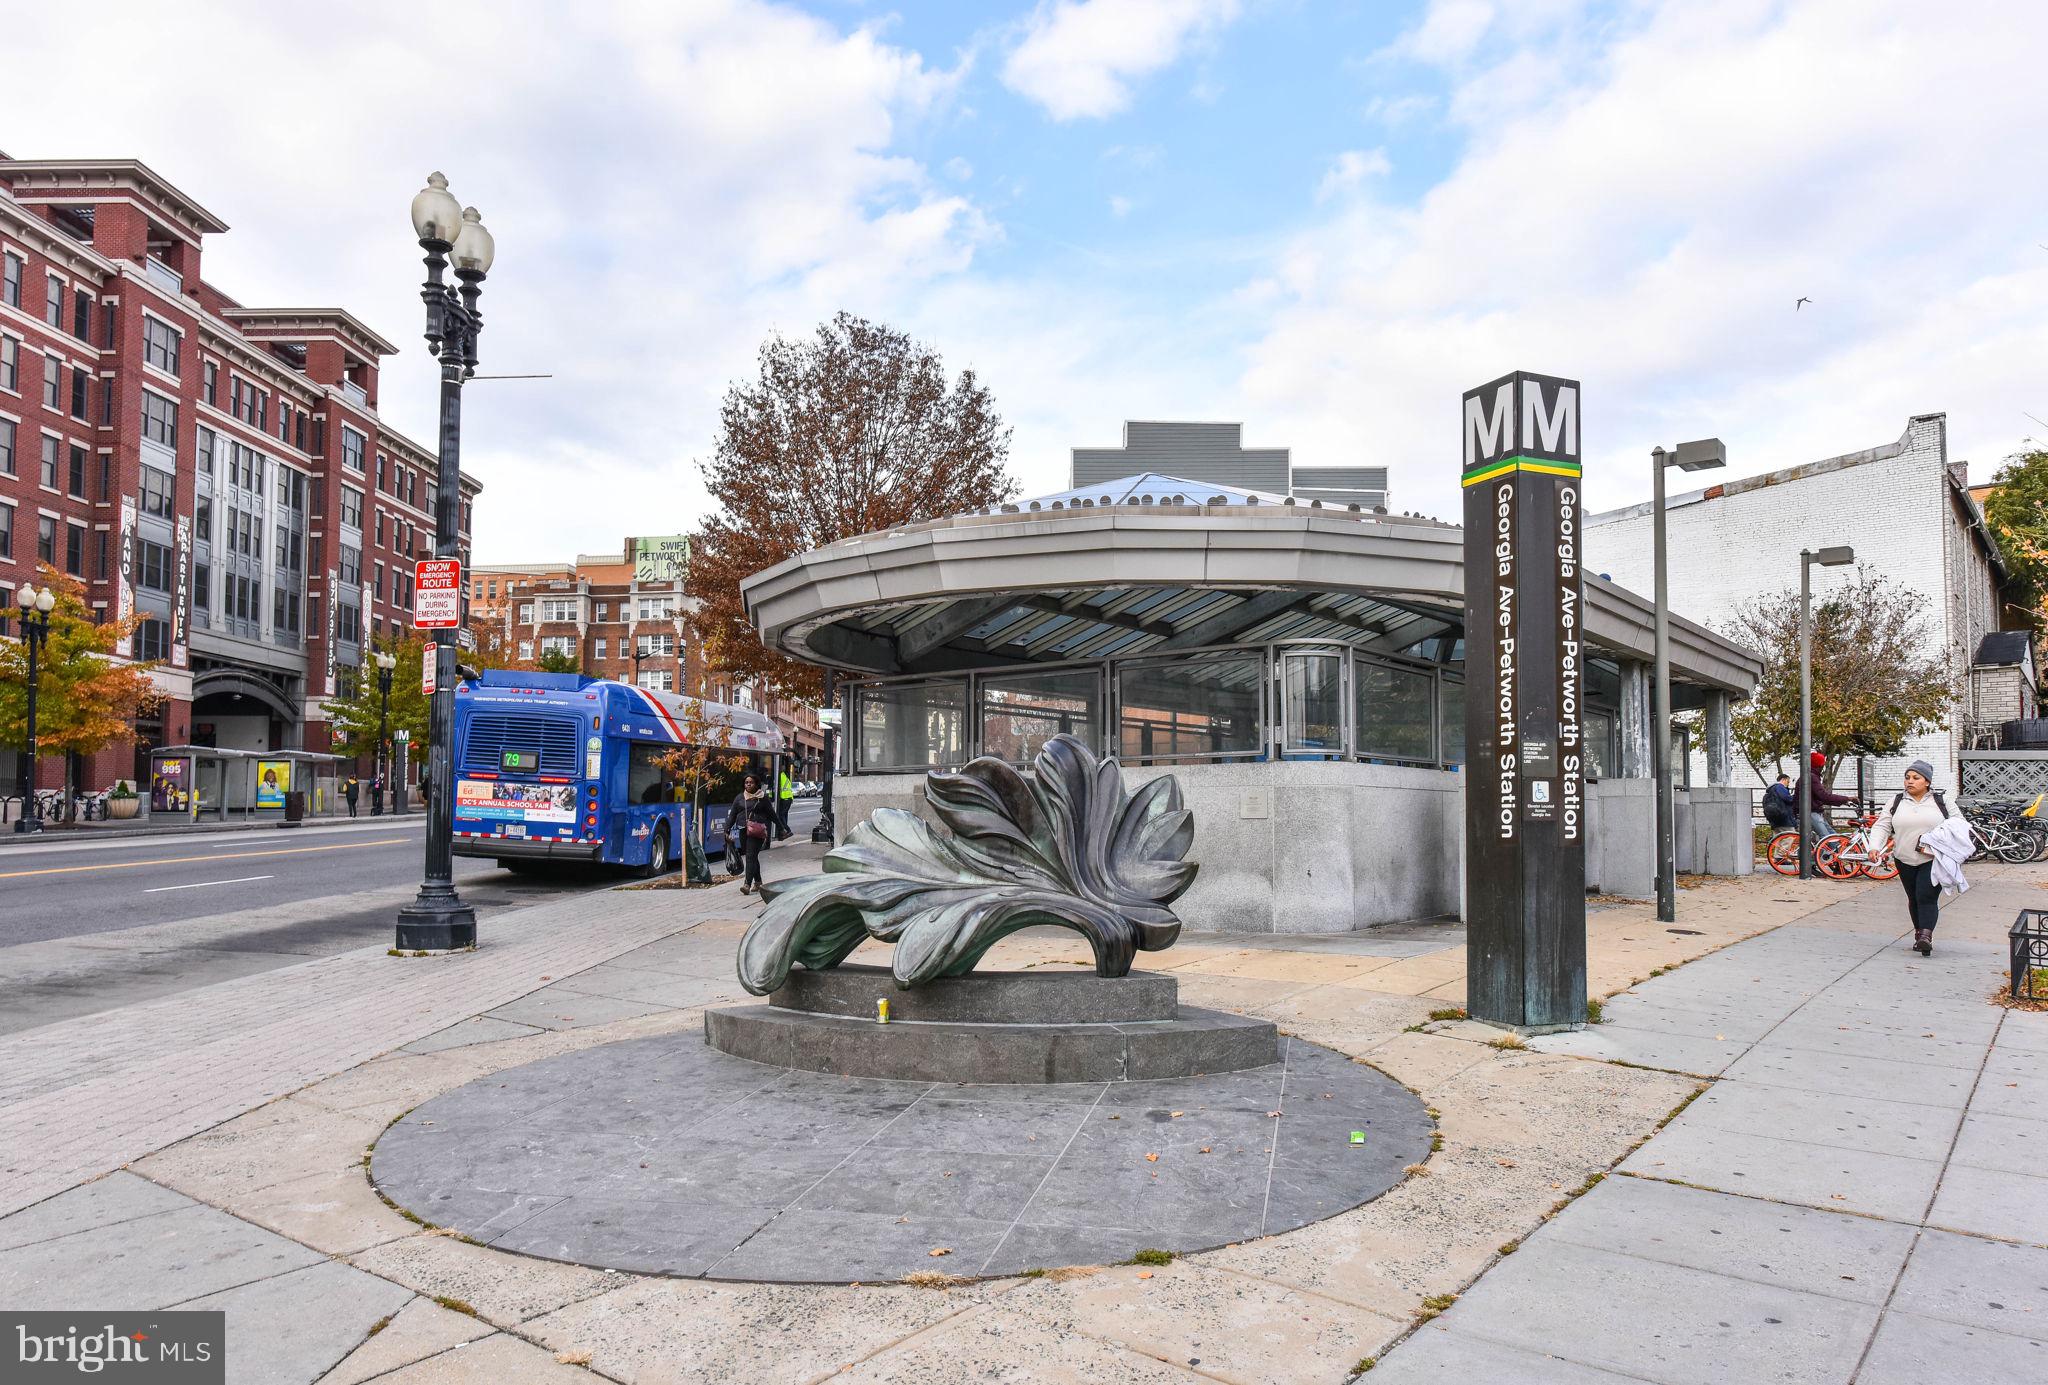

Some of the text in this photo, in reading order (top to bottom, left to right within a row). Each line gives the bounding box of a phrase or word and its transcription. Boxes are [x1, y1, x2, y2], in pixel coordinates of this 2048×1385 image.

[1522, 379, 1577, 456] M
[1465, 381, 1514, 466] M
[123, 510, 132, 575] BRAND
[660, 541, 688, 551] SWIFT
[639, 551, 687, 561] PETWORTH
[425, 563, 451, 572] SNOW
[419, 571, 456, 579] EMERGENCY
[177, 530, 187, 638] APARTMENTS
[422, 579, 453, 588] ROUTE
[418, 591, 456, 600] NO PARKING
[425, 601, 448, 609] DURING
[417, 609, 455, 618] EMERGENCY
[1495, 483, 1516, 839] Georgia Ave-Petworth Station
[1557, 486, 1580, 840] Georgia Ave-Petworth Station
[399, 730, 409, 740] M
[505, 752, 520, 767] 79
[161, 765, 182, 774] 995
[478, 799, 506, 807] ANNUAL
[506, 801, 534, 809] SCHOOL
